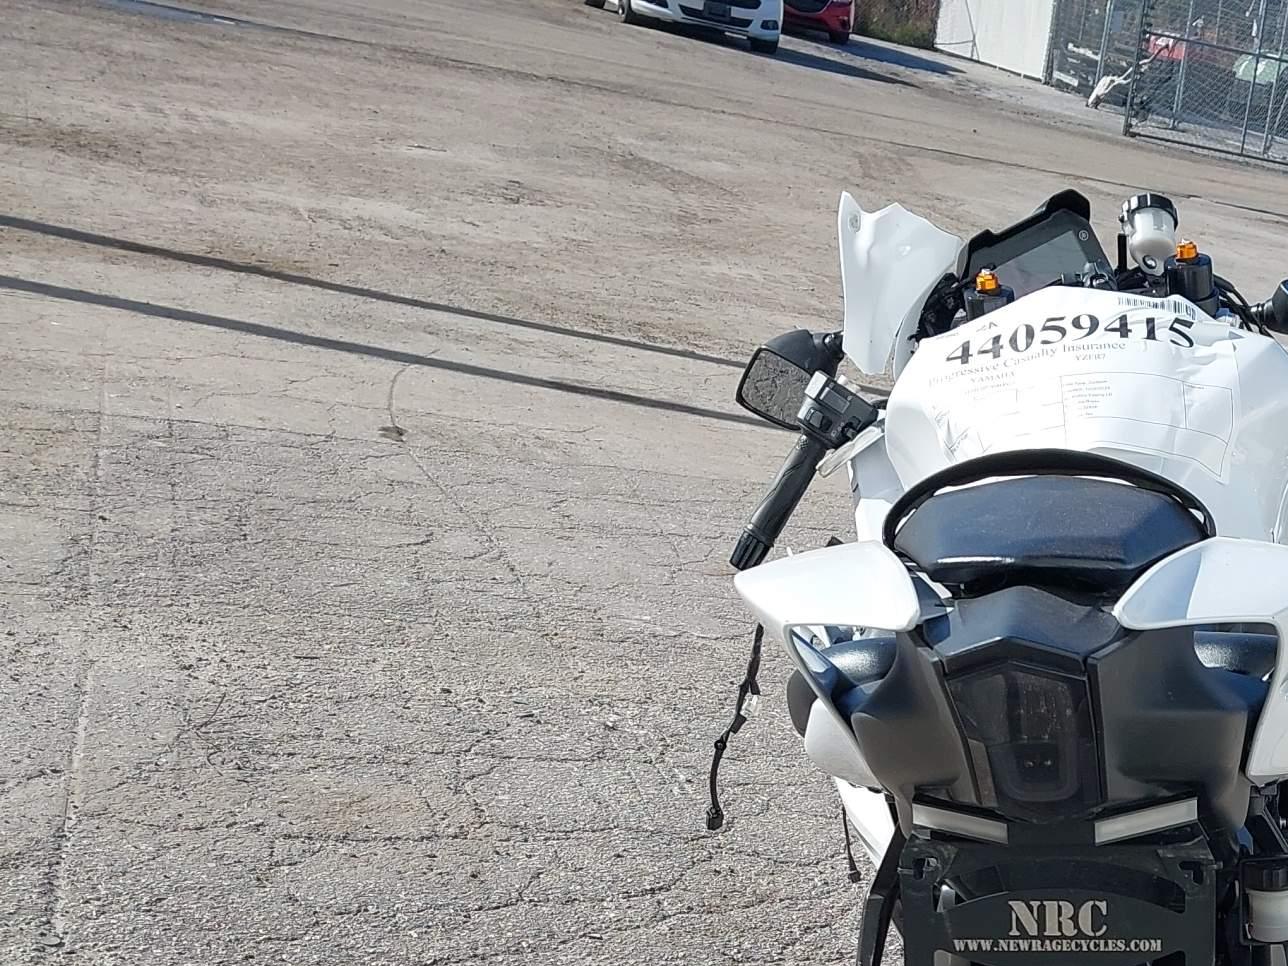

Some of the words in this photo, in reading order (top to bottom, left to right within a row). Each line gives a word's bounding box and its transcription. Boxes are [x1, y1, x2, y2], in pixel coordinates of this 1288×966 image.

[945, 313, 1195, 365] 44059415
[1063, 342, 1127, 353] Insurance
[1007, 900, 1108, 937] NRC
[952, 938, 1162, 952] WWW.NEWRAGECYCLES.COM
